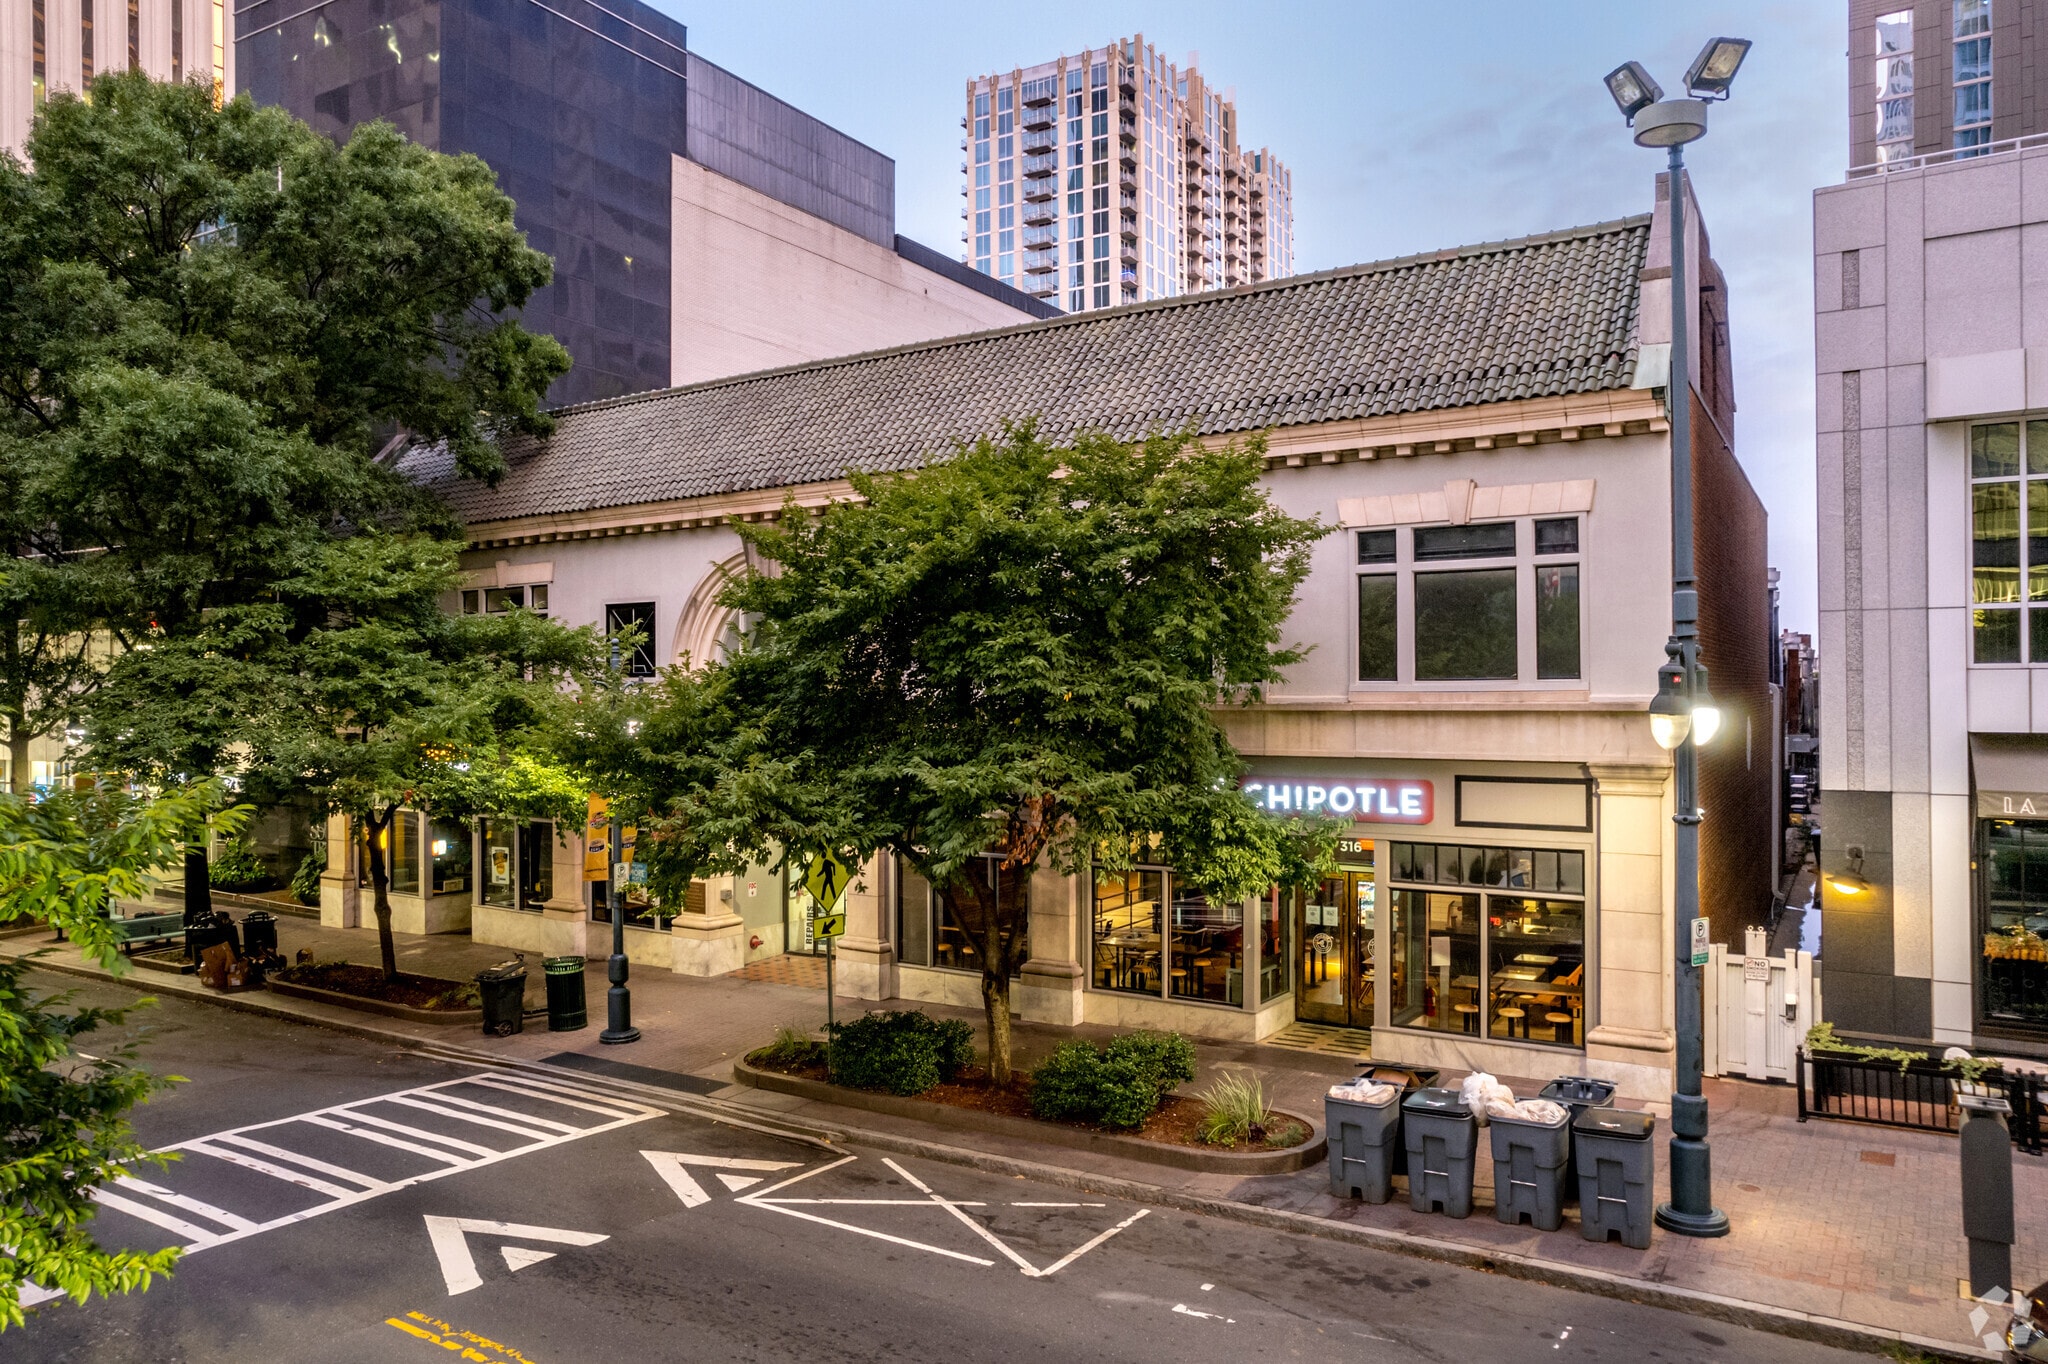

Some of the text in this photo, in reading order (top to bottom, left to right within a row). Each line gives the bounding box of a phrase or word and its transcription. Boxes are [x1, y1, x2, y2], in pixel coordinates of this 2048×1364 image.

[2003, 796, 2037, 815] LA
[1340, 840, 1362, 853] 316
[805, 905, 814, 945] REPAIRS
